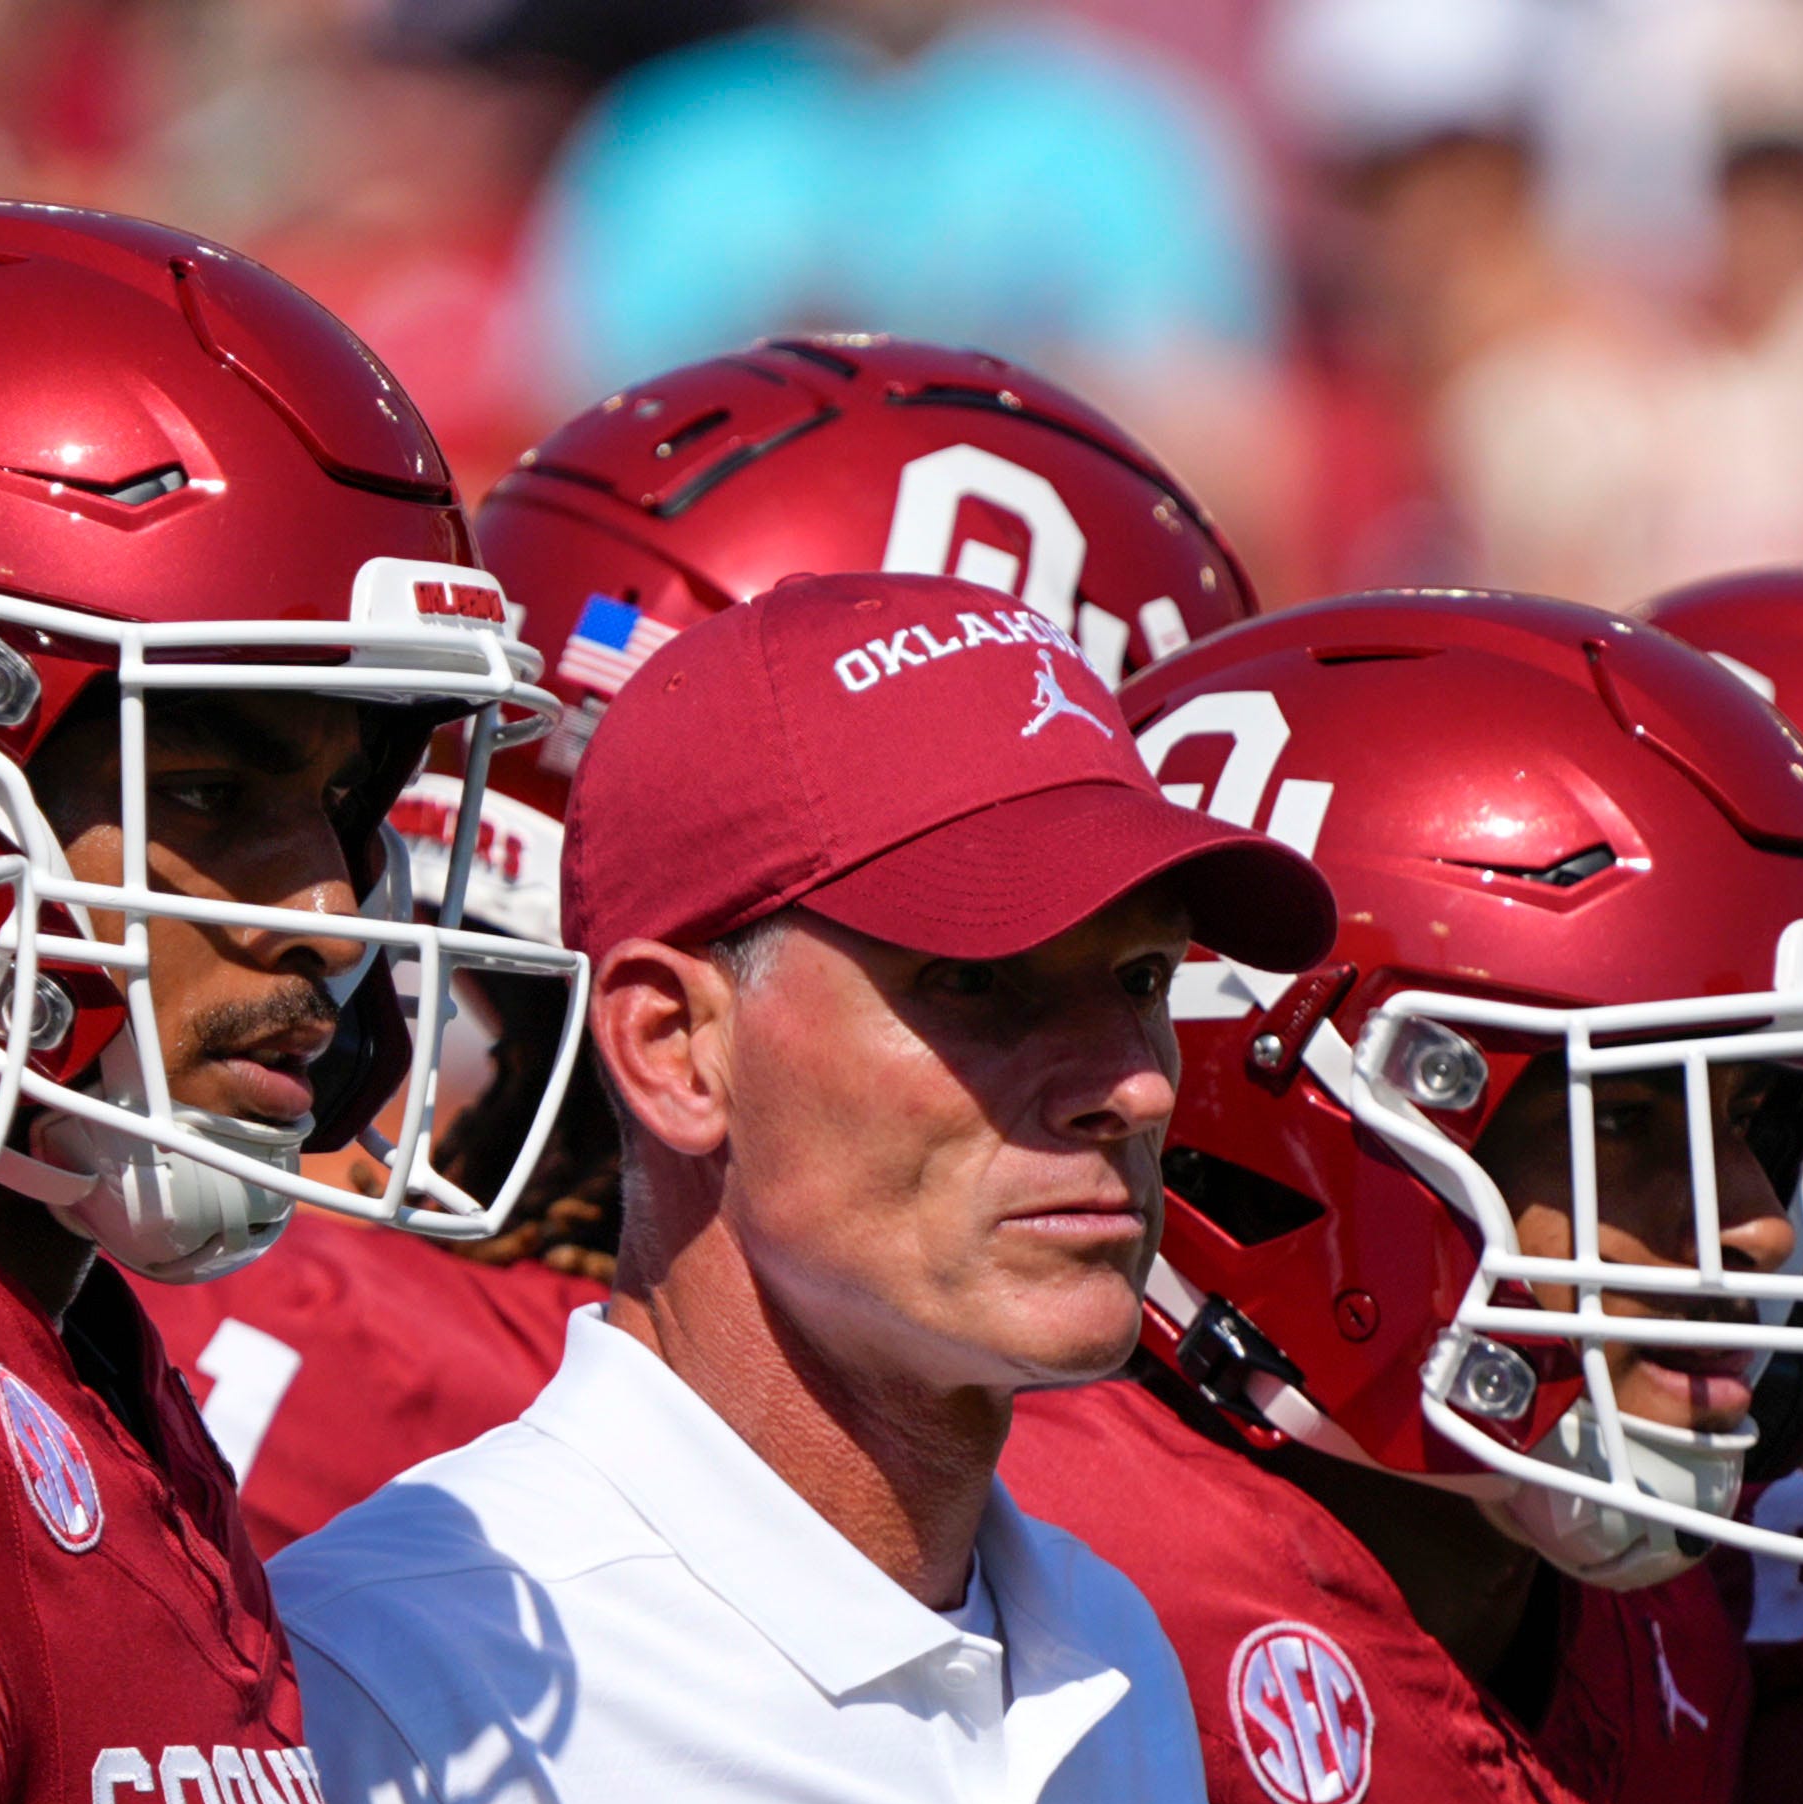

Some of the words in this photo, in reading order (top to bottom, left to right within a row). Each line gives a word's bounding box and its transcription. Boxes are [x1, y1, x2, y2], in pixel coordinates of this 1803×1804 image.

[834, 610, 1099, 692] OKLAHO
[2, 1376, 97, 1536] SEC
[1241, 1636, 1368, 1803] SEC
